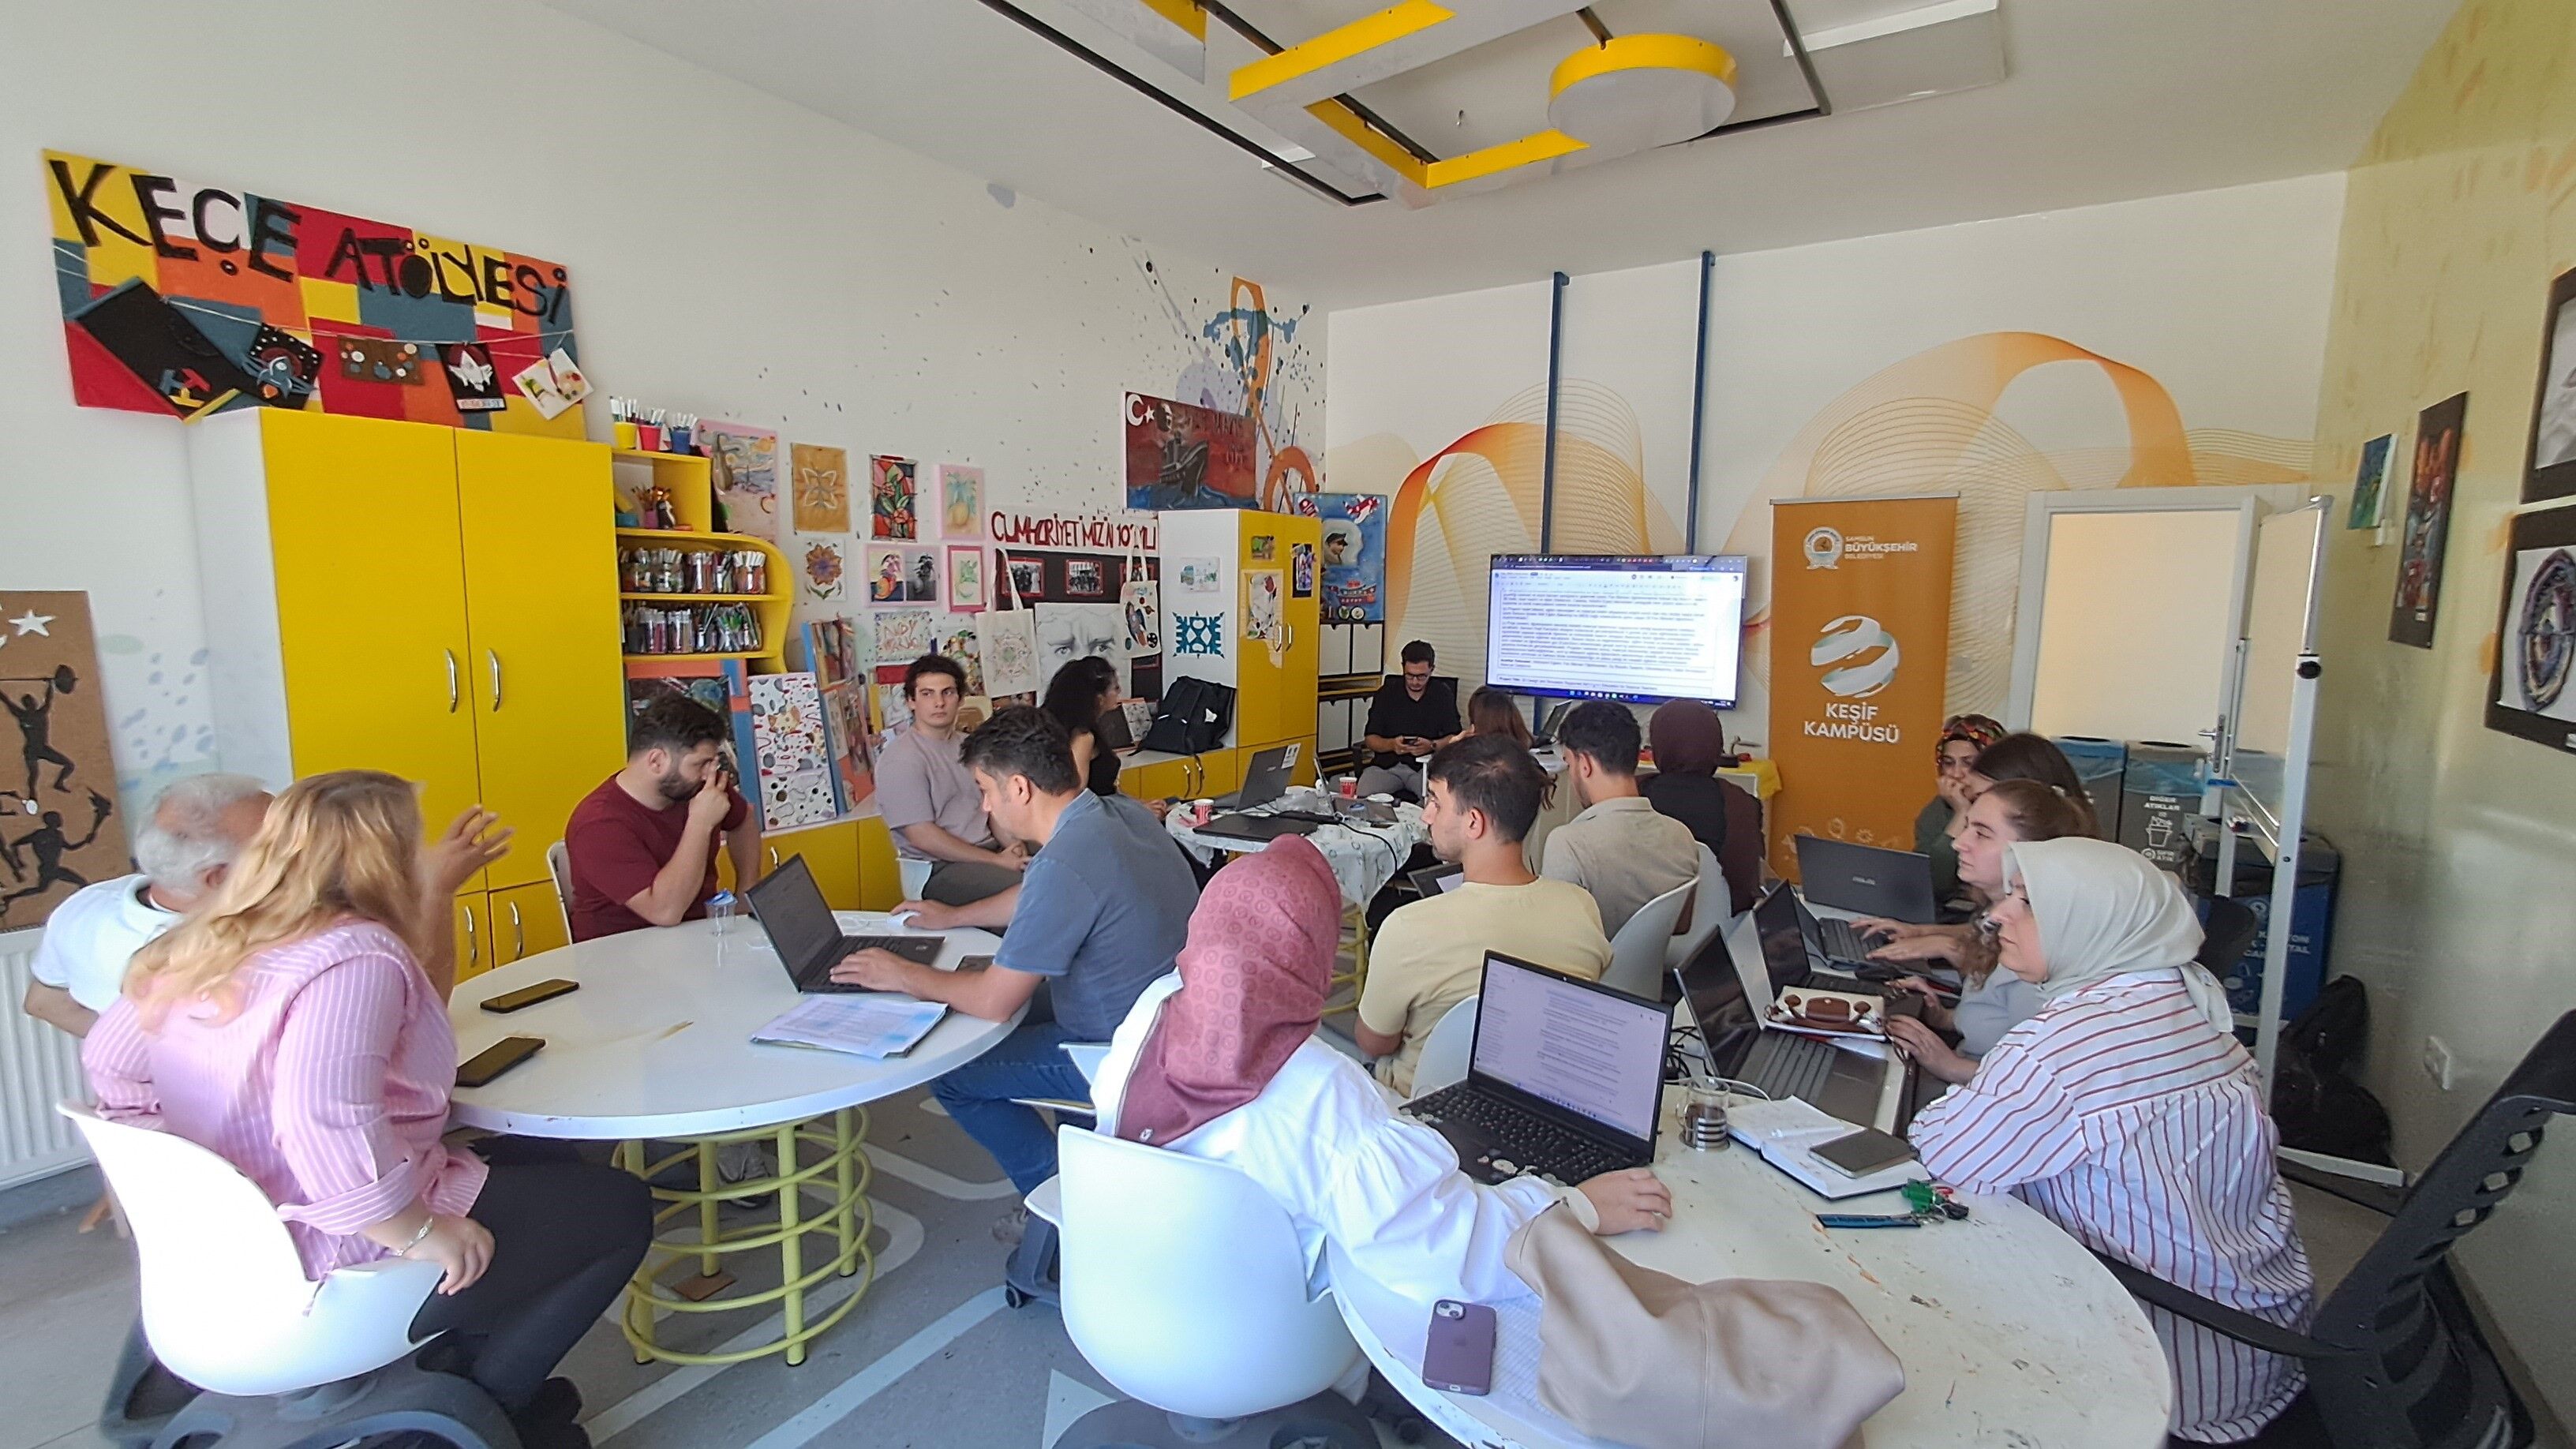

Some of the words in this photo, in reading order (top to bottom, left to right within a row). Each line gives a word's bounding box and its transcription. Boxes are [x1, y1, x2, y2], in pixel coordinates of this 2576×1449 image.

[50, 159, 301, 283] KEÇE
[1844, 541, 1918, 552] BÜYÜKŞEHİR
[1825, 702, 1878, 724] KEŞİF
[1804, 721, 1900, 743] KAMPÜSÜ
